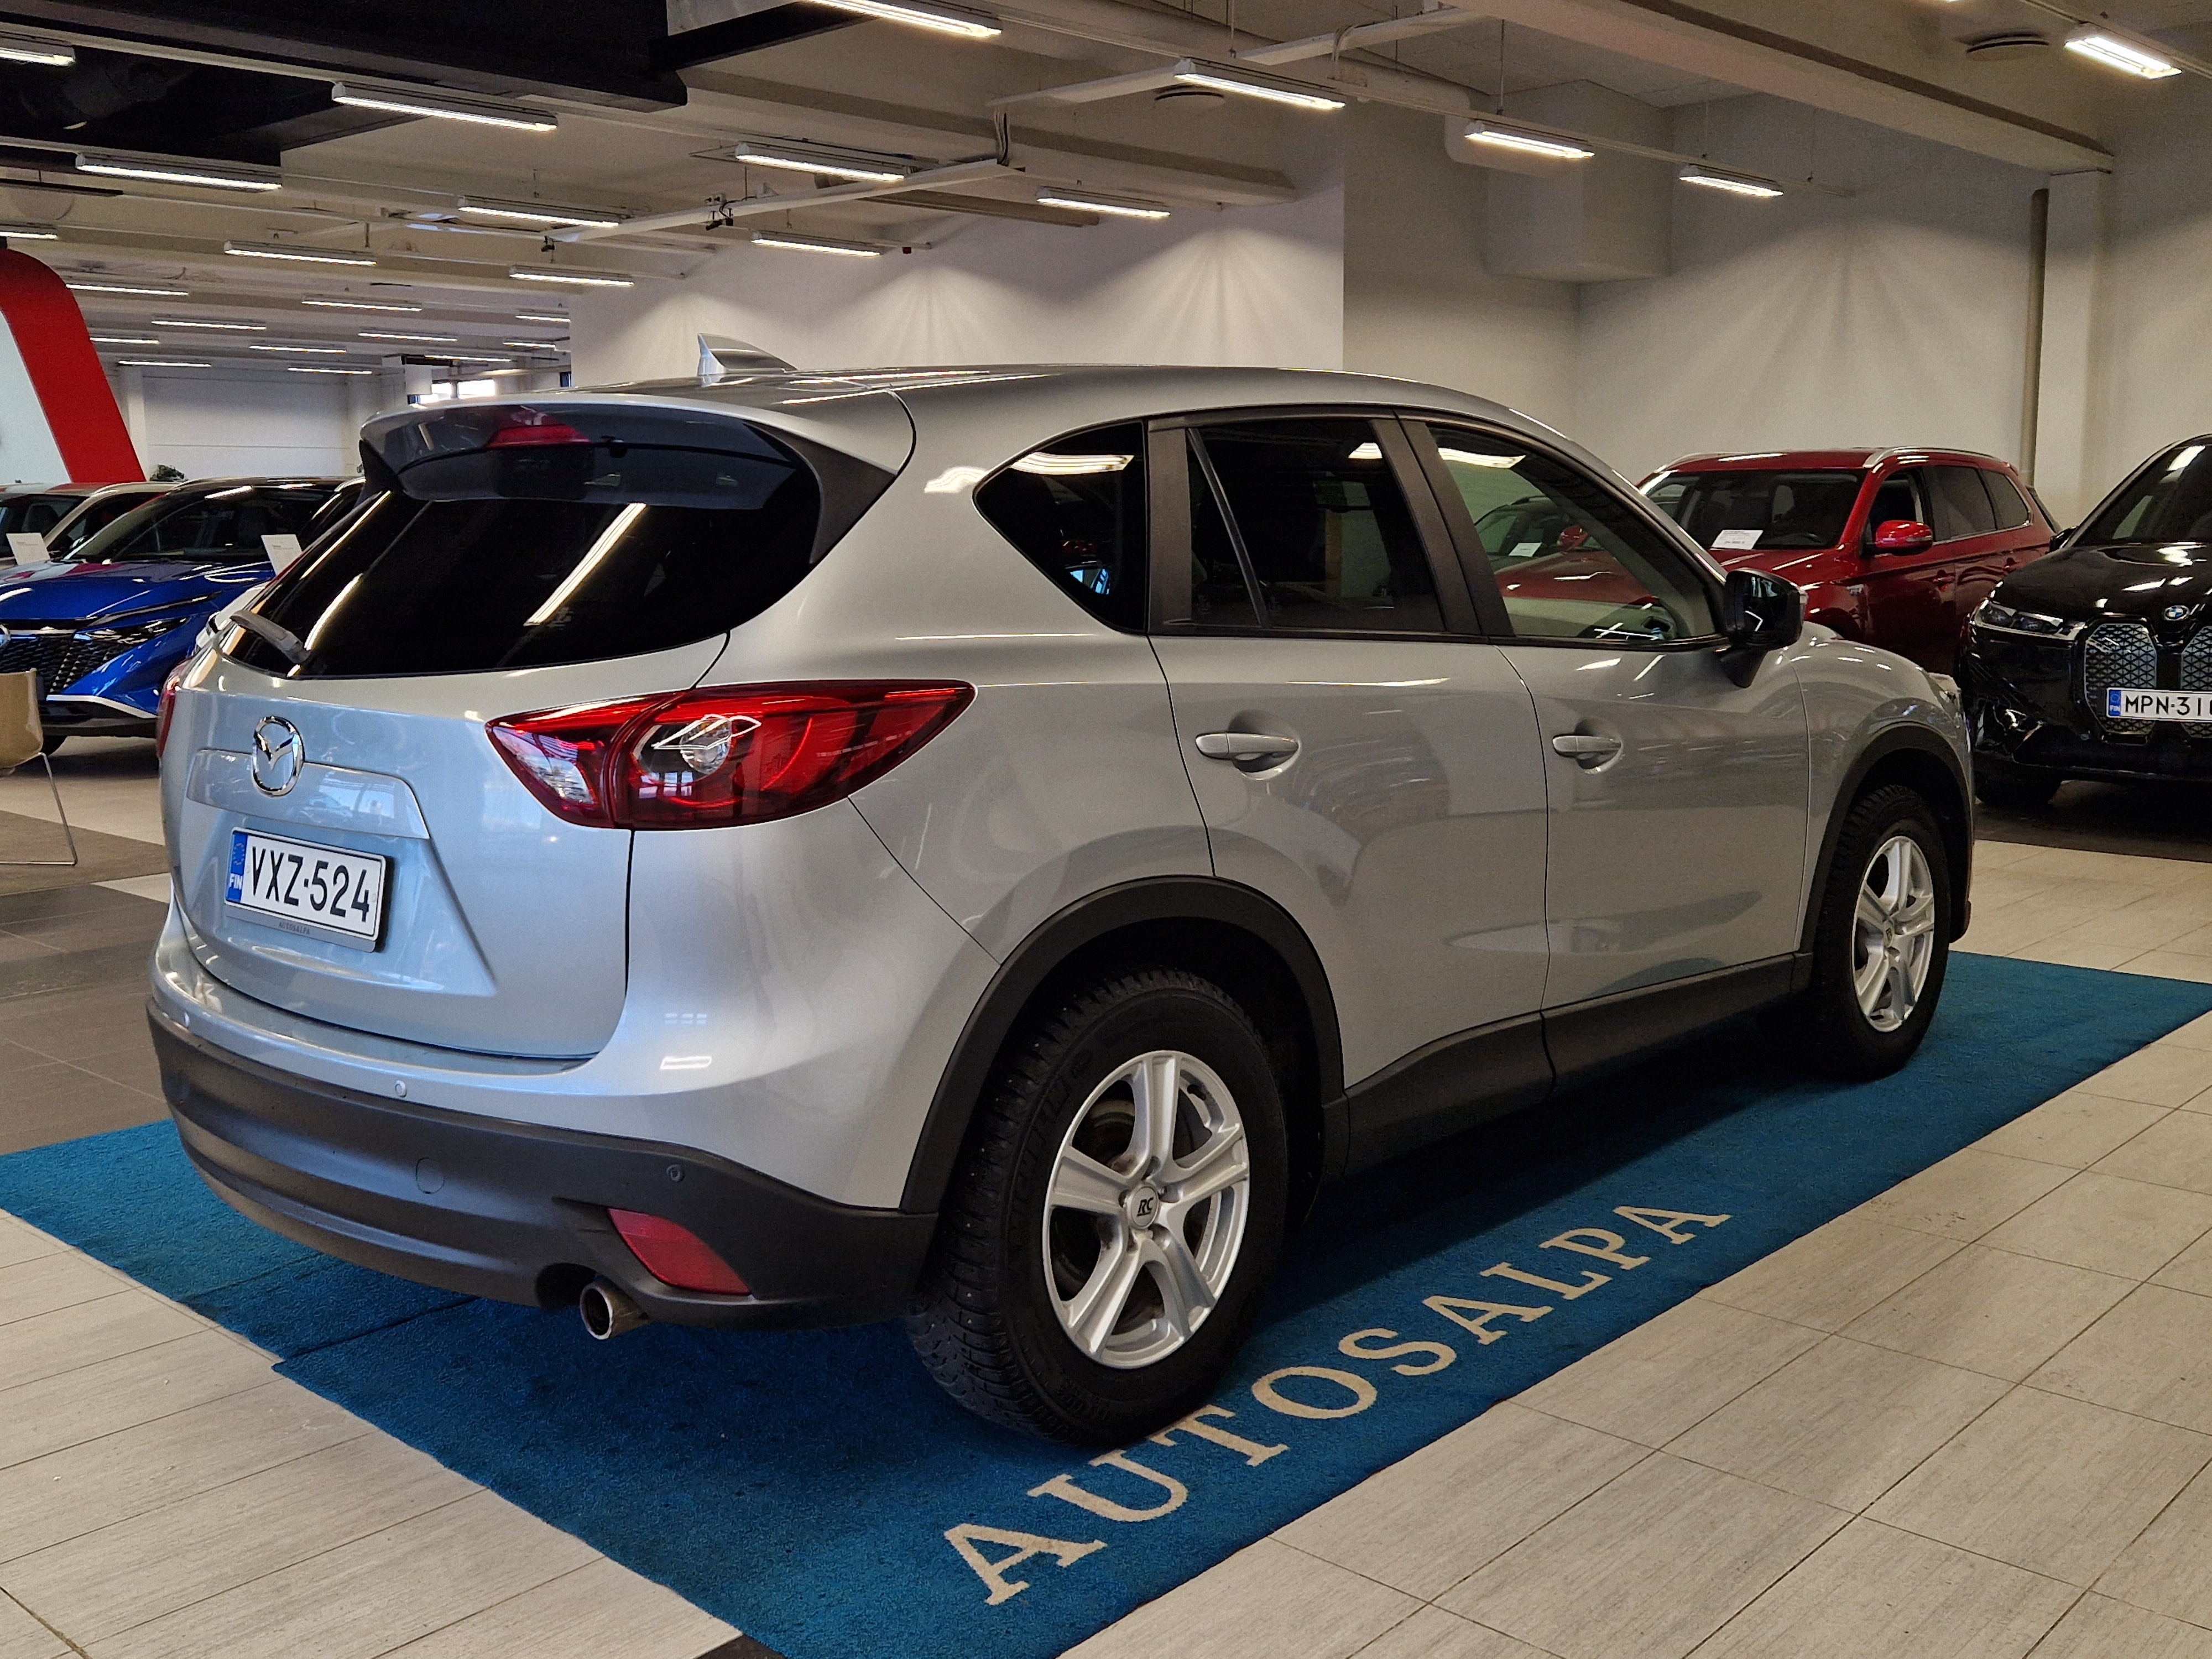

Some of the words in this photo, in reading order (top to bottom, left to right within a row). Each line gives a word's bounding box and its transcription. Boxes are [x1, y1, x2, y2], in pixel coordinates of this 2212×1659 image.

[229, 873, 243, 890] FIN
[252, 846, 370, 923] VXZ-524
[1138, 1197, 1154, 1214] RC
[943, 1205, 1731, 1605] AUTOSALPA
